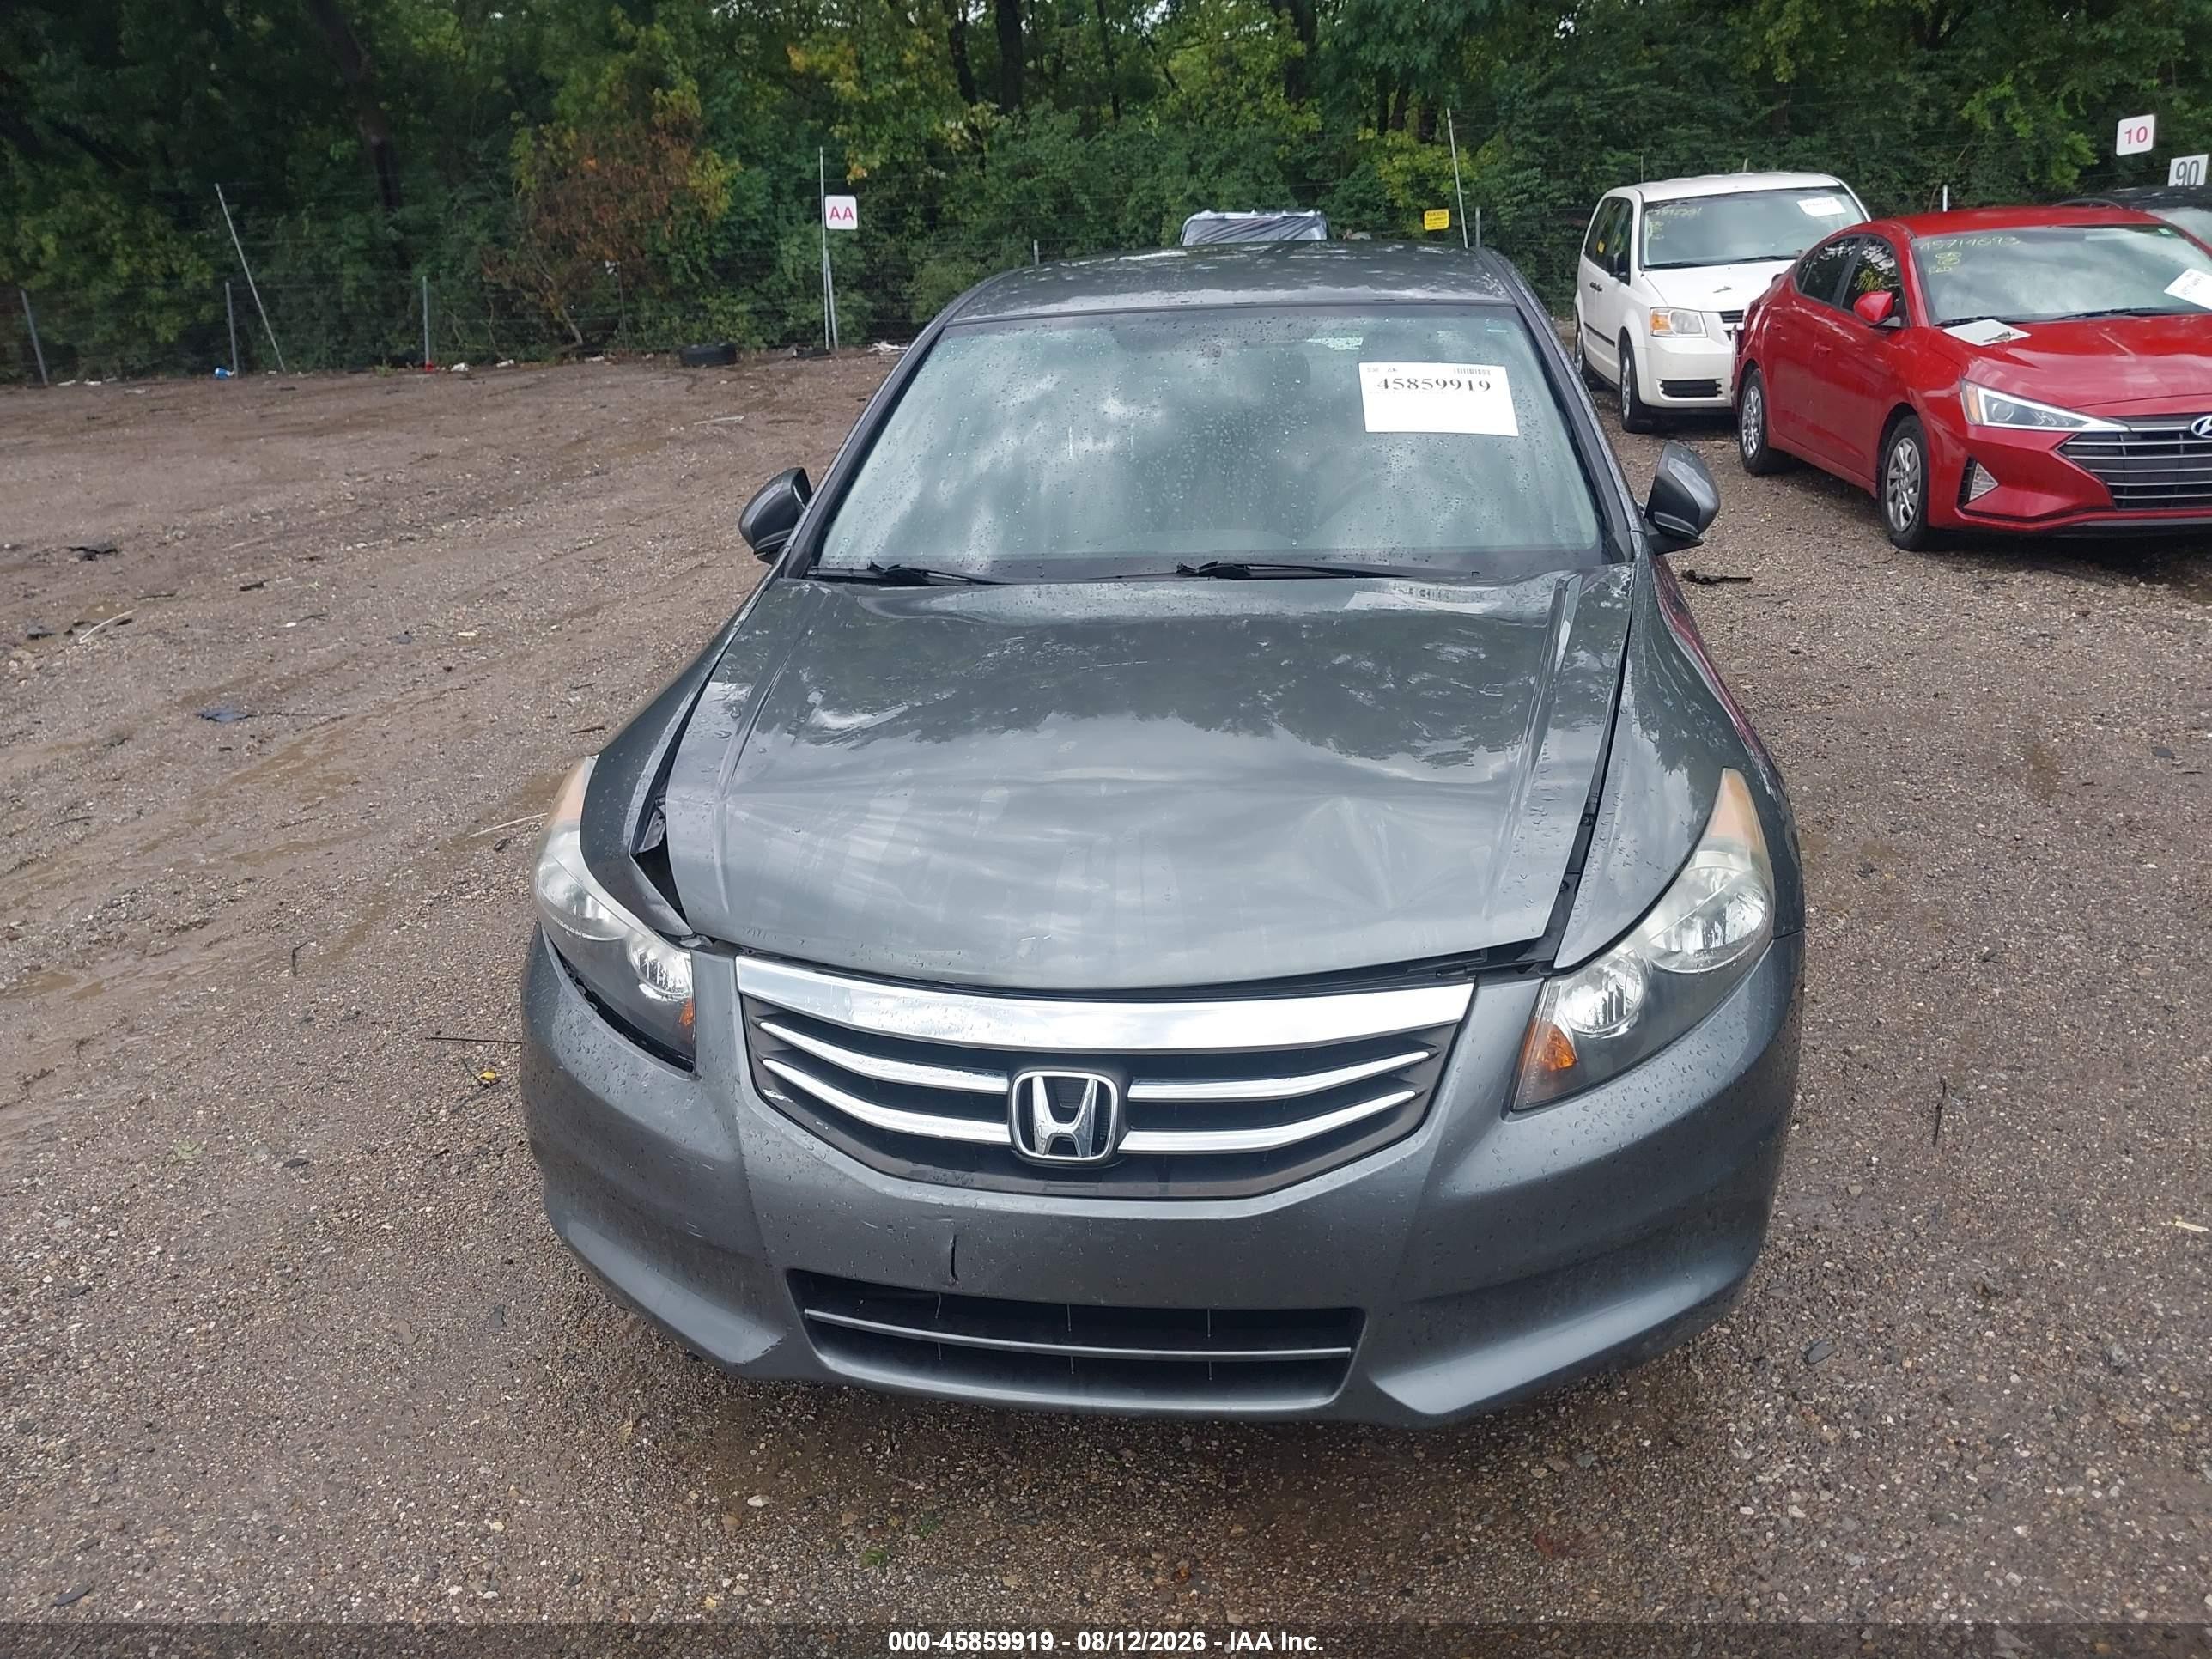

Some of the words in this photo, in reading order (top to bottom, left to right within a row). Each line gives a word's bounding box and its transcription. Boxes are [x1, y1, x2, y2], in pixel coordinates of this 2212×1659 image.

[2124, 125, 2148, 145] 10
[2175, 160, 2200, 186] 90
[830, 205, 854, 221] AA
[1376, 377, 1492, 392] 45859919
